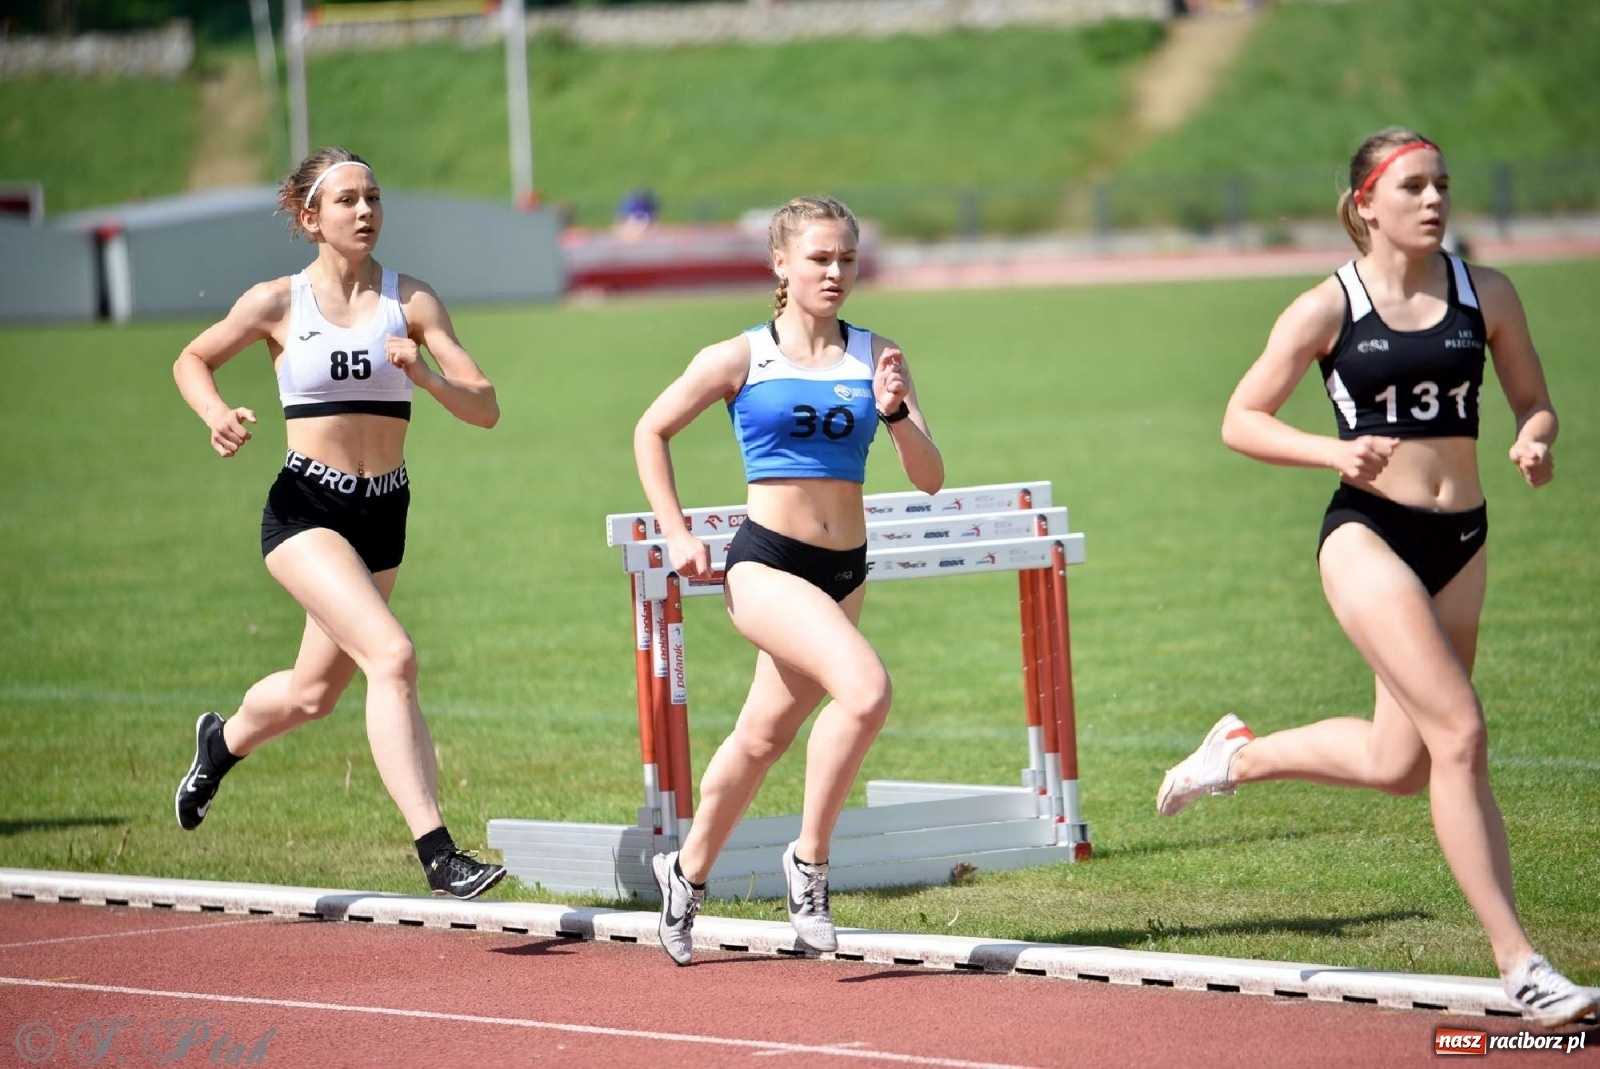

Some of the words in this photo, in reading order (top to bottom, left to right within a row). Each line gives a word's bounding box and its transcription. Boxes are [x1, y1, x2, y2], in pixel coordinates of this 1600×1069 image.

[330, 350, 371, 380] 85
[789, 404, 855, 440] 30
[1375, 381, 1470, 423] 131
[304, 460, 358, 494] PRO
[365, 464, 408, 498] NIKE
[656, 617, 668, 661] polanik
[673, 644, 686, 689] polanik
